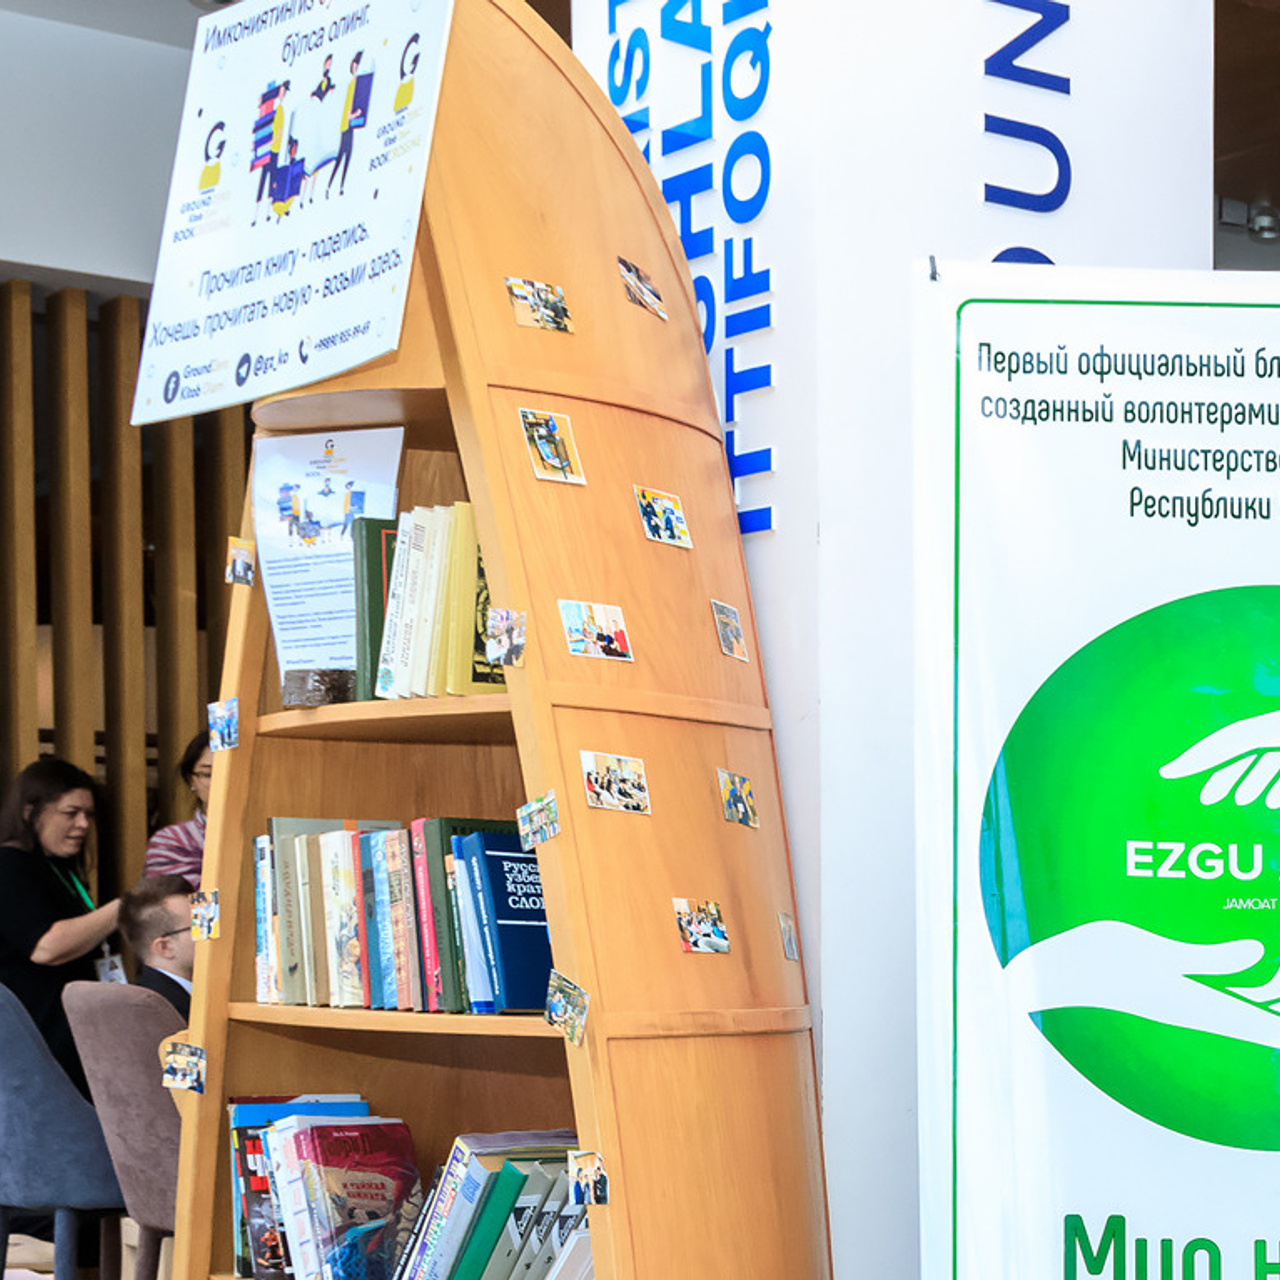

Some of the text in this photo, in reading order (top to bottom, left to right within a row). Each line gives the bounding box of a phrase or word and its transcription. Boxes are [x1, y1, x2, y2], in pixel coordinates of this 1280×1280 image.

[198, 260, 262, 297] Прочитал
[263, 249, 298, 277] книгу
[149, 320, 201, 348] Хочешь
[203, 299, 269, 337] прочитать
[272, 283, 312, 316] новую
[322, 265, 367, 300] возьми
[977, 342, 1069, 378] Первый
[1077, 345, 1246, 384] официальный
[980, 393, 1115, 424] созданный
[1123, 400, 1280, 433] волонтерами
[1130, 487, 1271, 527] Республики
[1126, 840, 1264, 881] EZGU
[1222, 898, 1278, 911] JAMOAT
